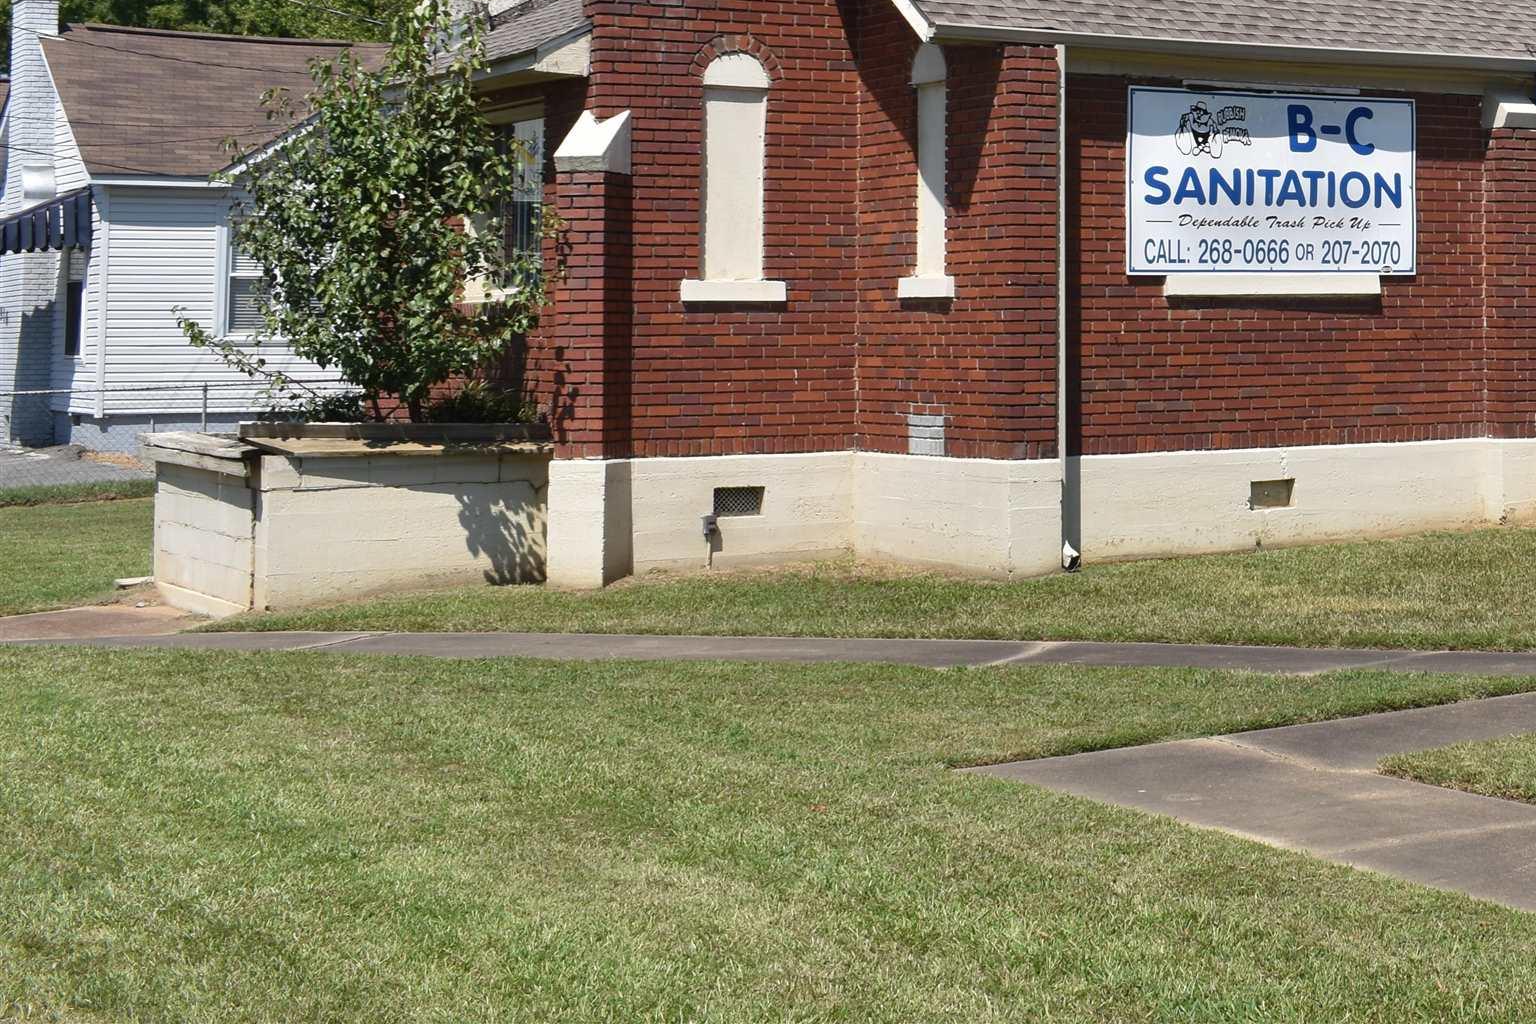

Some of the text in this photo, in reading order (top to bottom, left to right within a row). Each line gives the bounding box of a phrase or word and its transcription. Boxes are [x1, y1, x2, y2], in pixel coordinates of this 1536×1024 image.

[1287, 104, 1376, 156] B-C
[1143, 165, 1402, 209] SANITATION
[1178, 213, 1372, 231] Dependable Trash Pick Up
[1143, 238, 1401, 265] CALL: 268-0666 OR 207-2070
